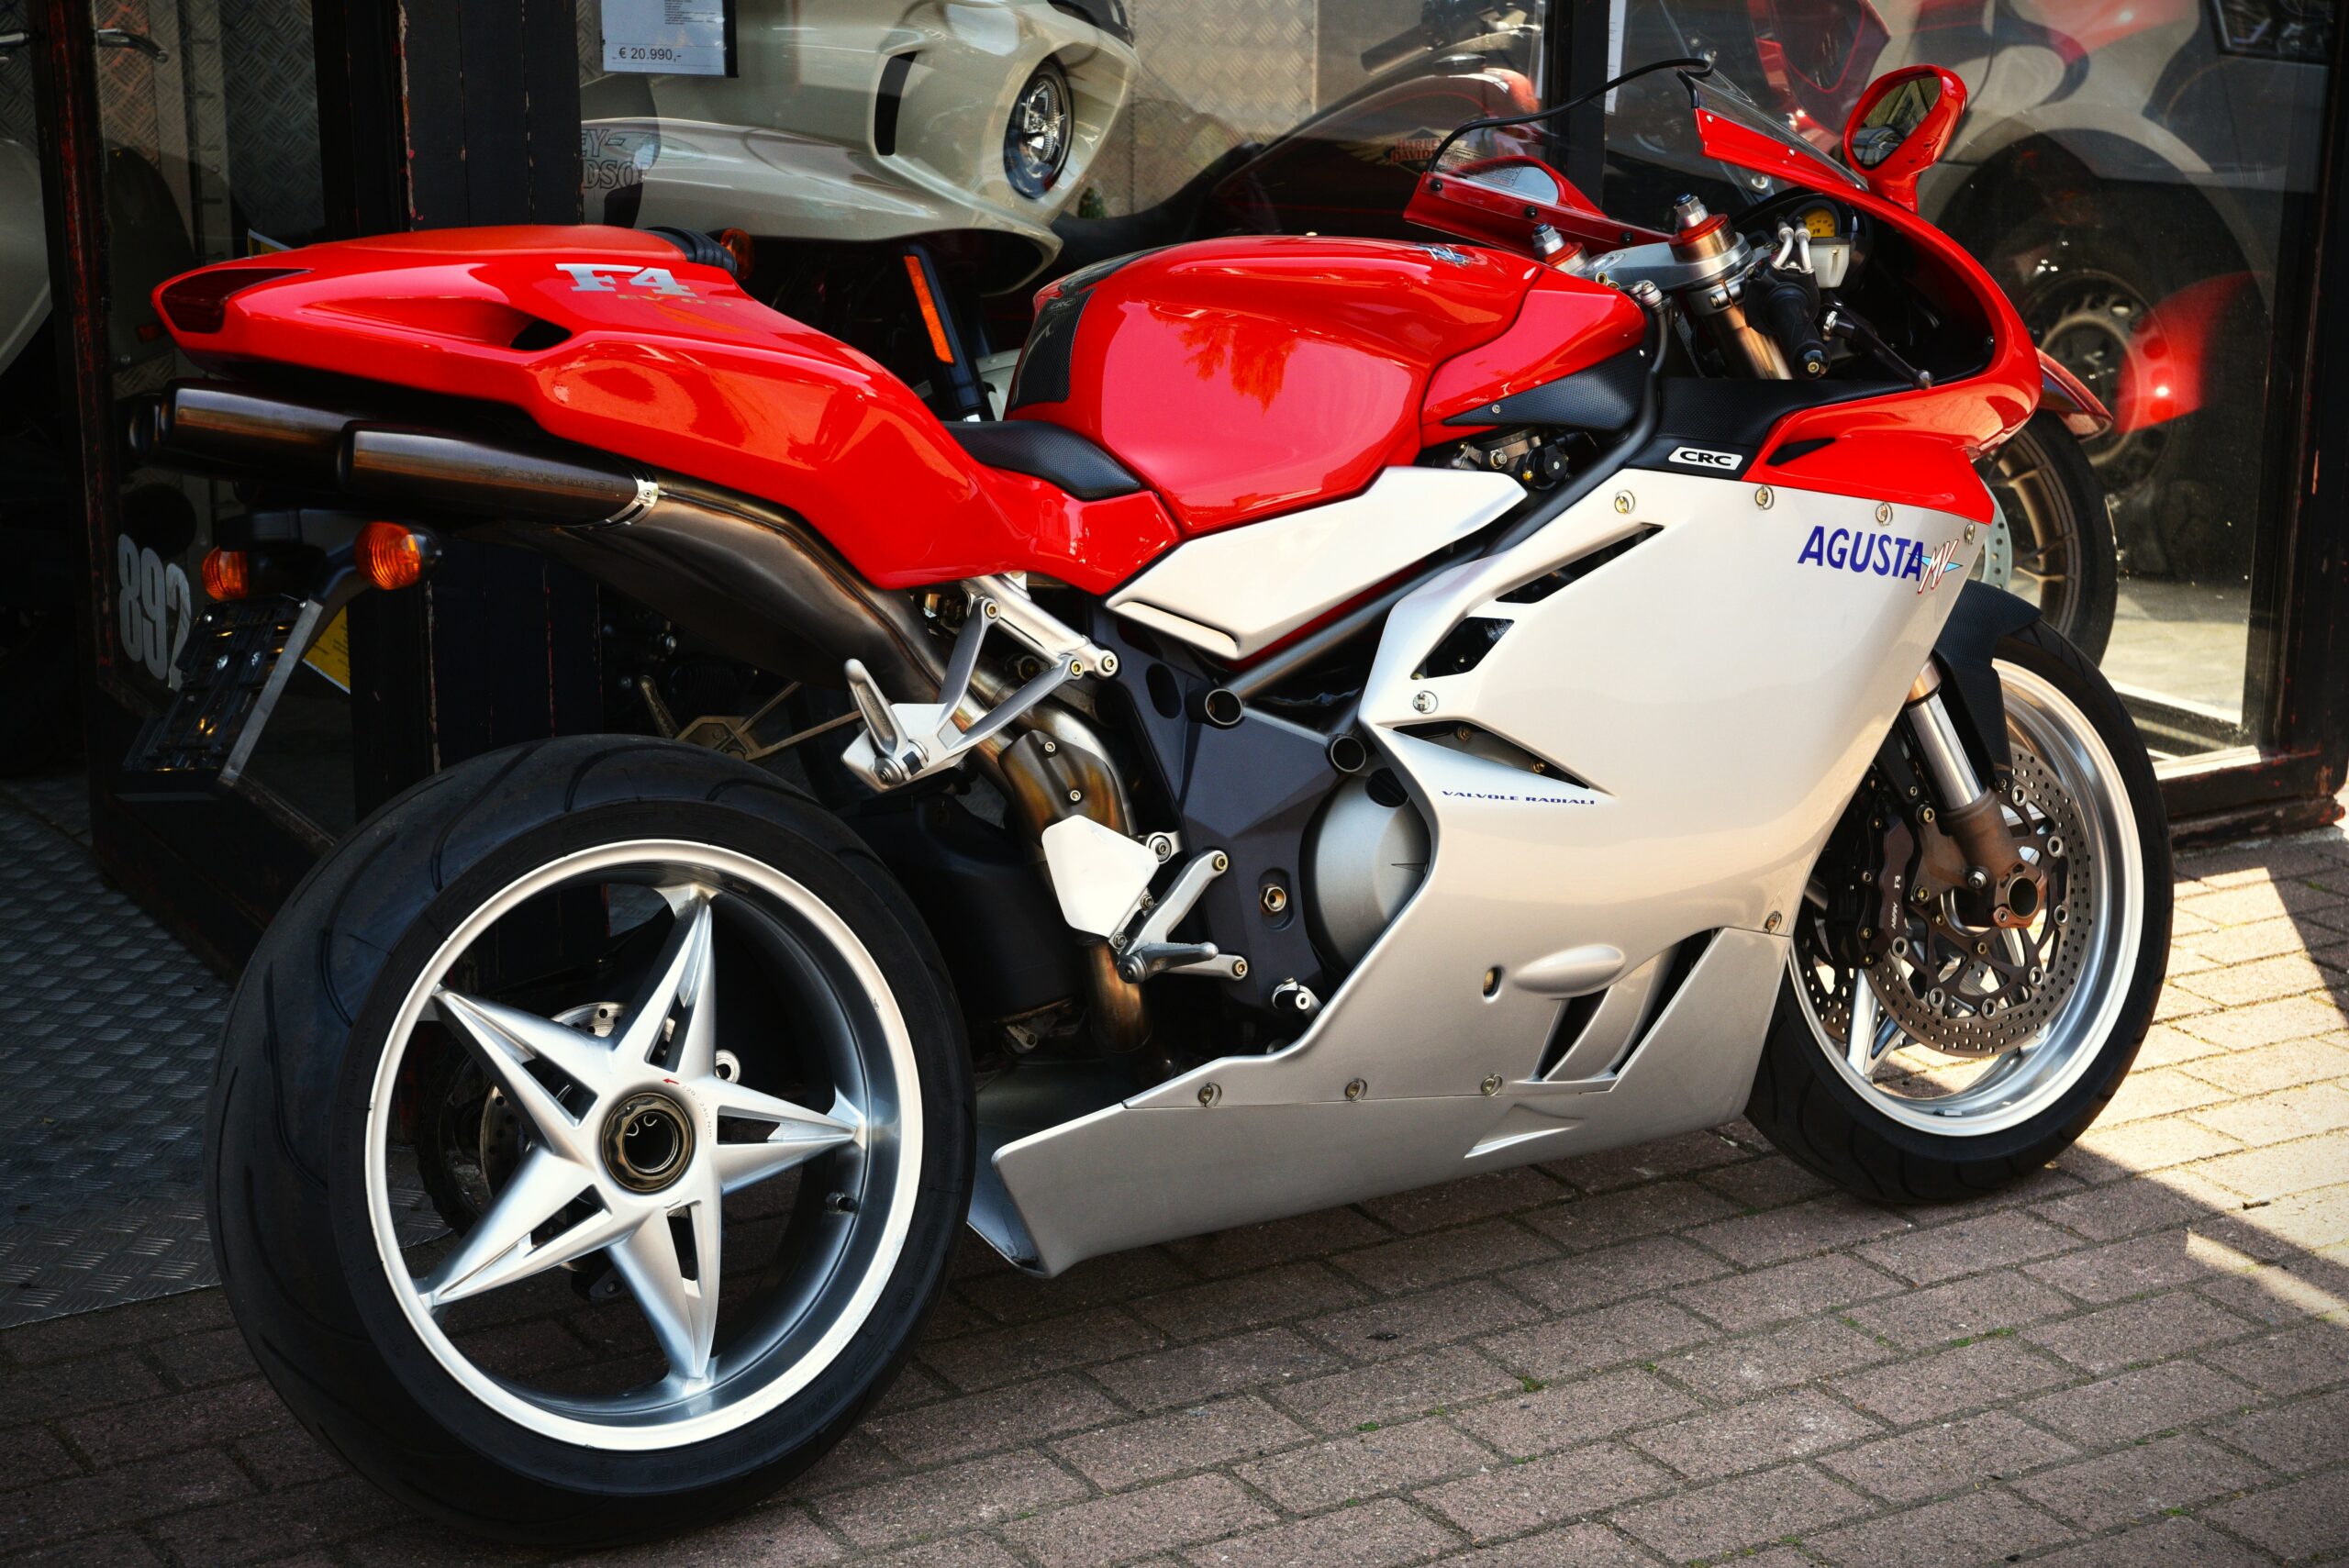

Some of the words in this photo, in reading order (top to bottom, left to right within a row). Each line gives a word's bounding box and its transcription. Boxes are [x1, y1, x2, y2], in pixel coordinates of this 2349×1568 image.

[618, 47, 627, 59] €
[630, 48, 682, 61] 20.990,-
[555, 263, 697, 297] F4
[1680, 450, 1732, 466] CRC
[1798, 525, 1924, 582] AGUSTA
[1917, 538, 1960, 595] MV
[117, 534, 192, 692] 892
[1442, 790, 1520, 801] VALVOLE
[1524, 795, 1596, 806] RADIALI
